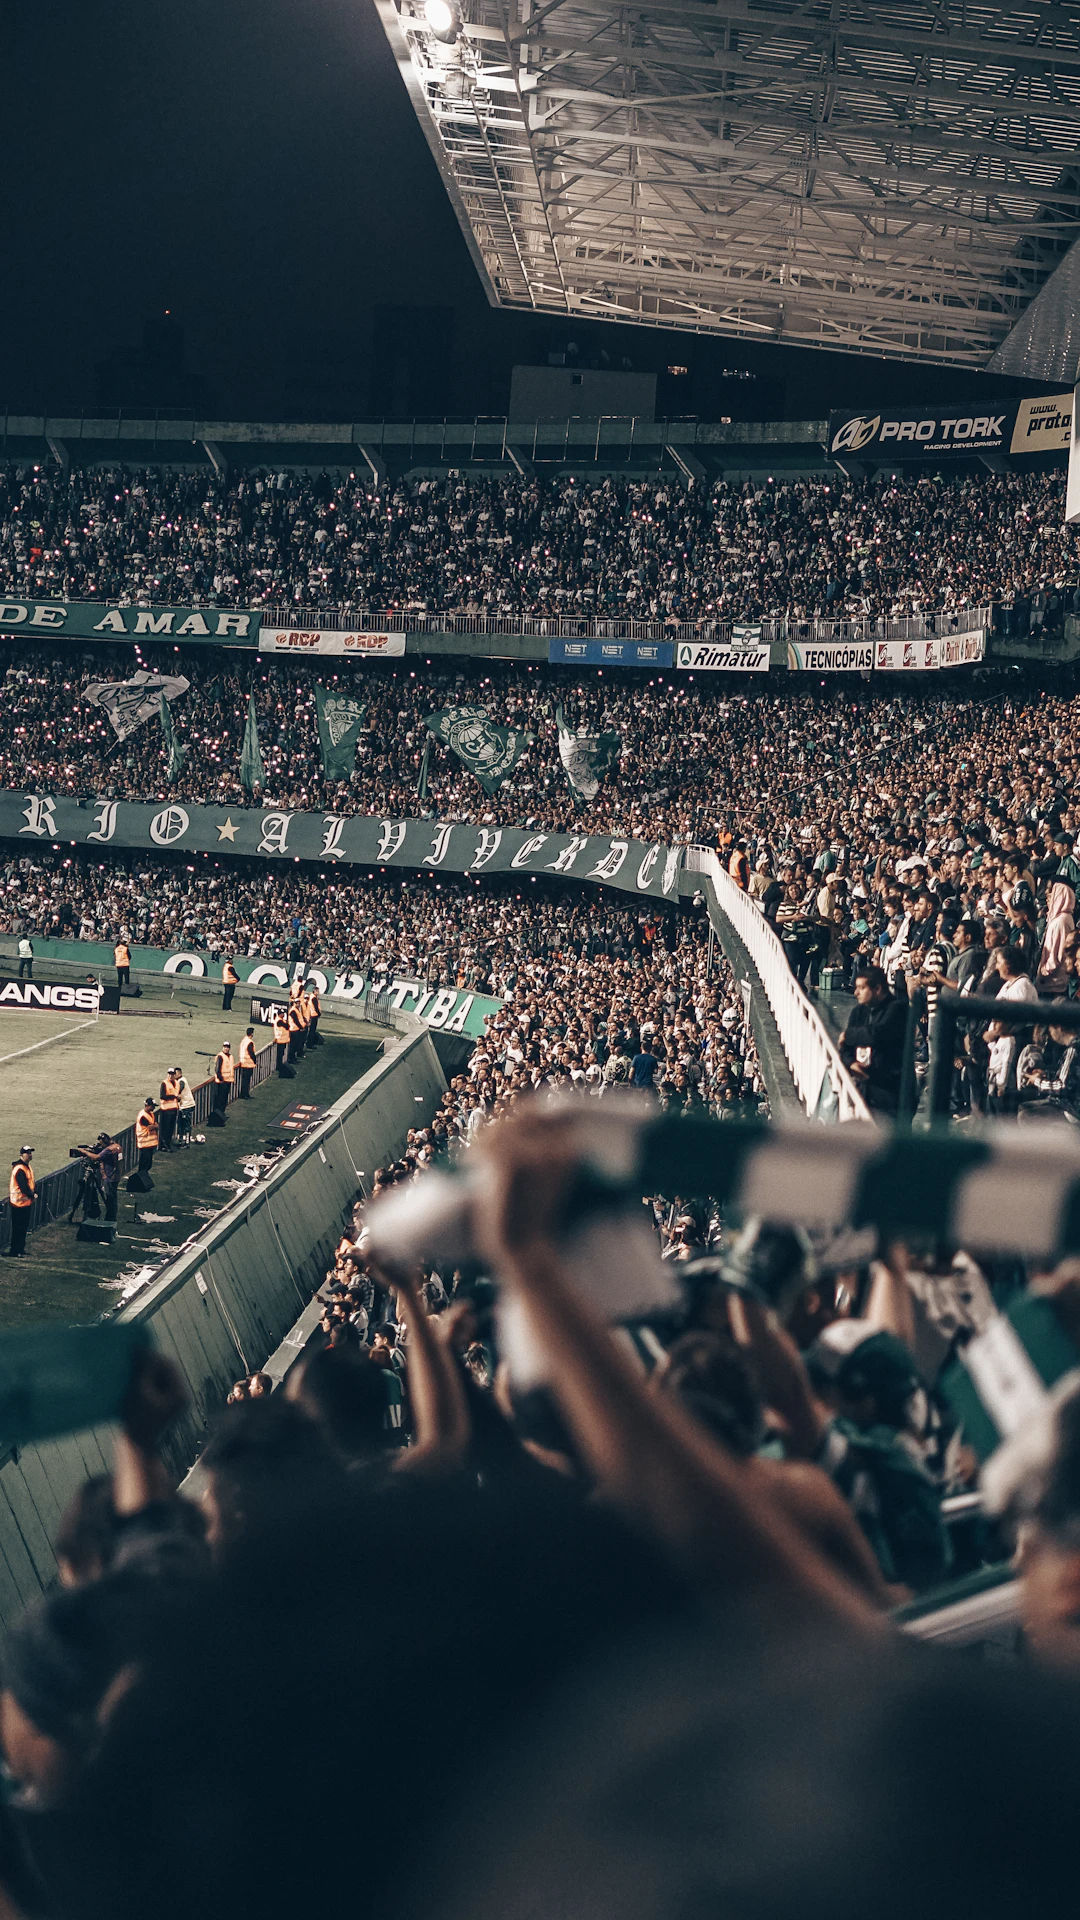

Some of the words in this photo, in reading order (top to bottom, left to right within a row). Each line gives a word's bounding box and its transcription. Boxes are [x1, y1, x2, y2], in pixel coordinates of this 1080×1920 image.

[878, 420, 936, 442] PRO
[939, 415, 1006, 440] TORK
[1026, 411, 1072, 436] proto
[952, 440, 1003, 449] DEVELOPMENT
[94, 607, 253, 637] AMAR
[565, 644, 587, 653] NET
[602, 645, 624, 655] NET
[637, 646, 658, 656] NET
[693, 647, 767, 668] Rimatur
[805, 645, 872, 669] TECNICÓPIAS
